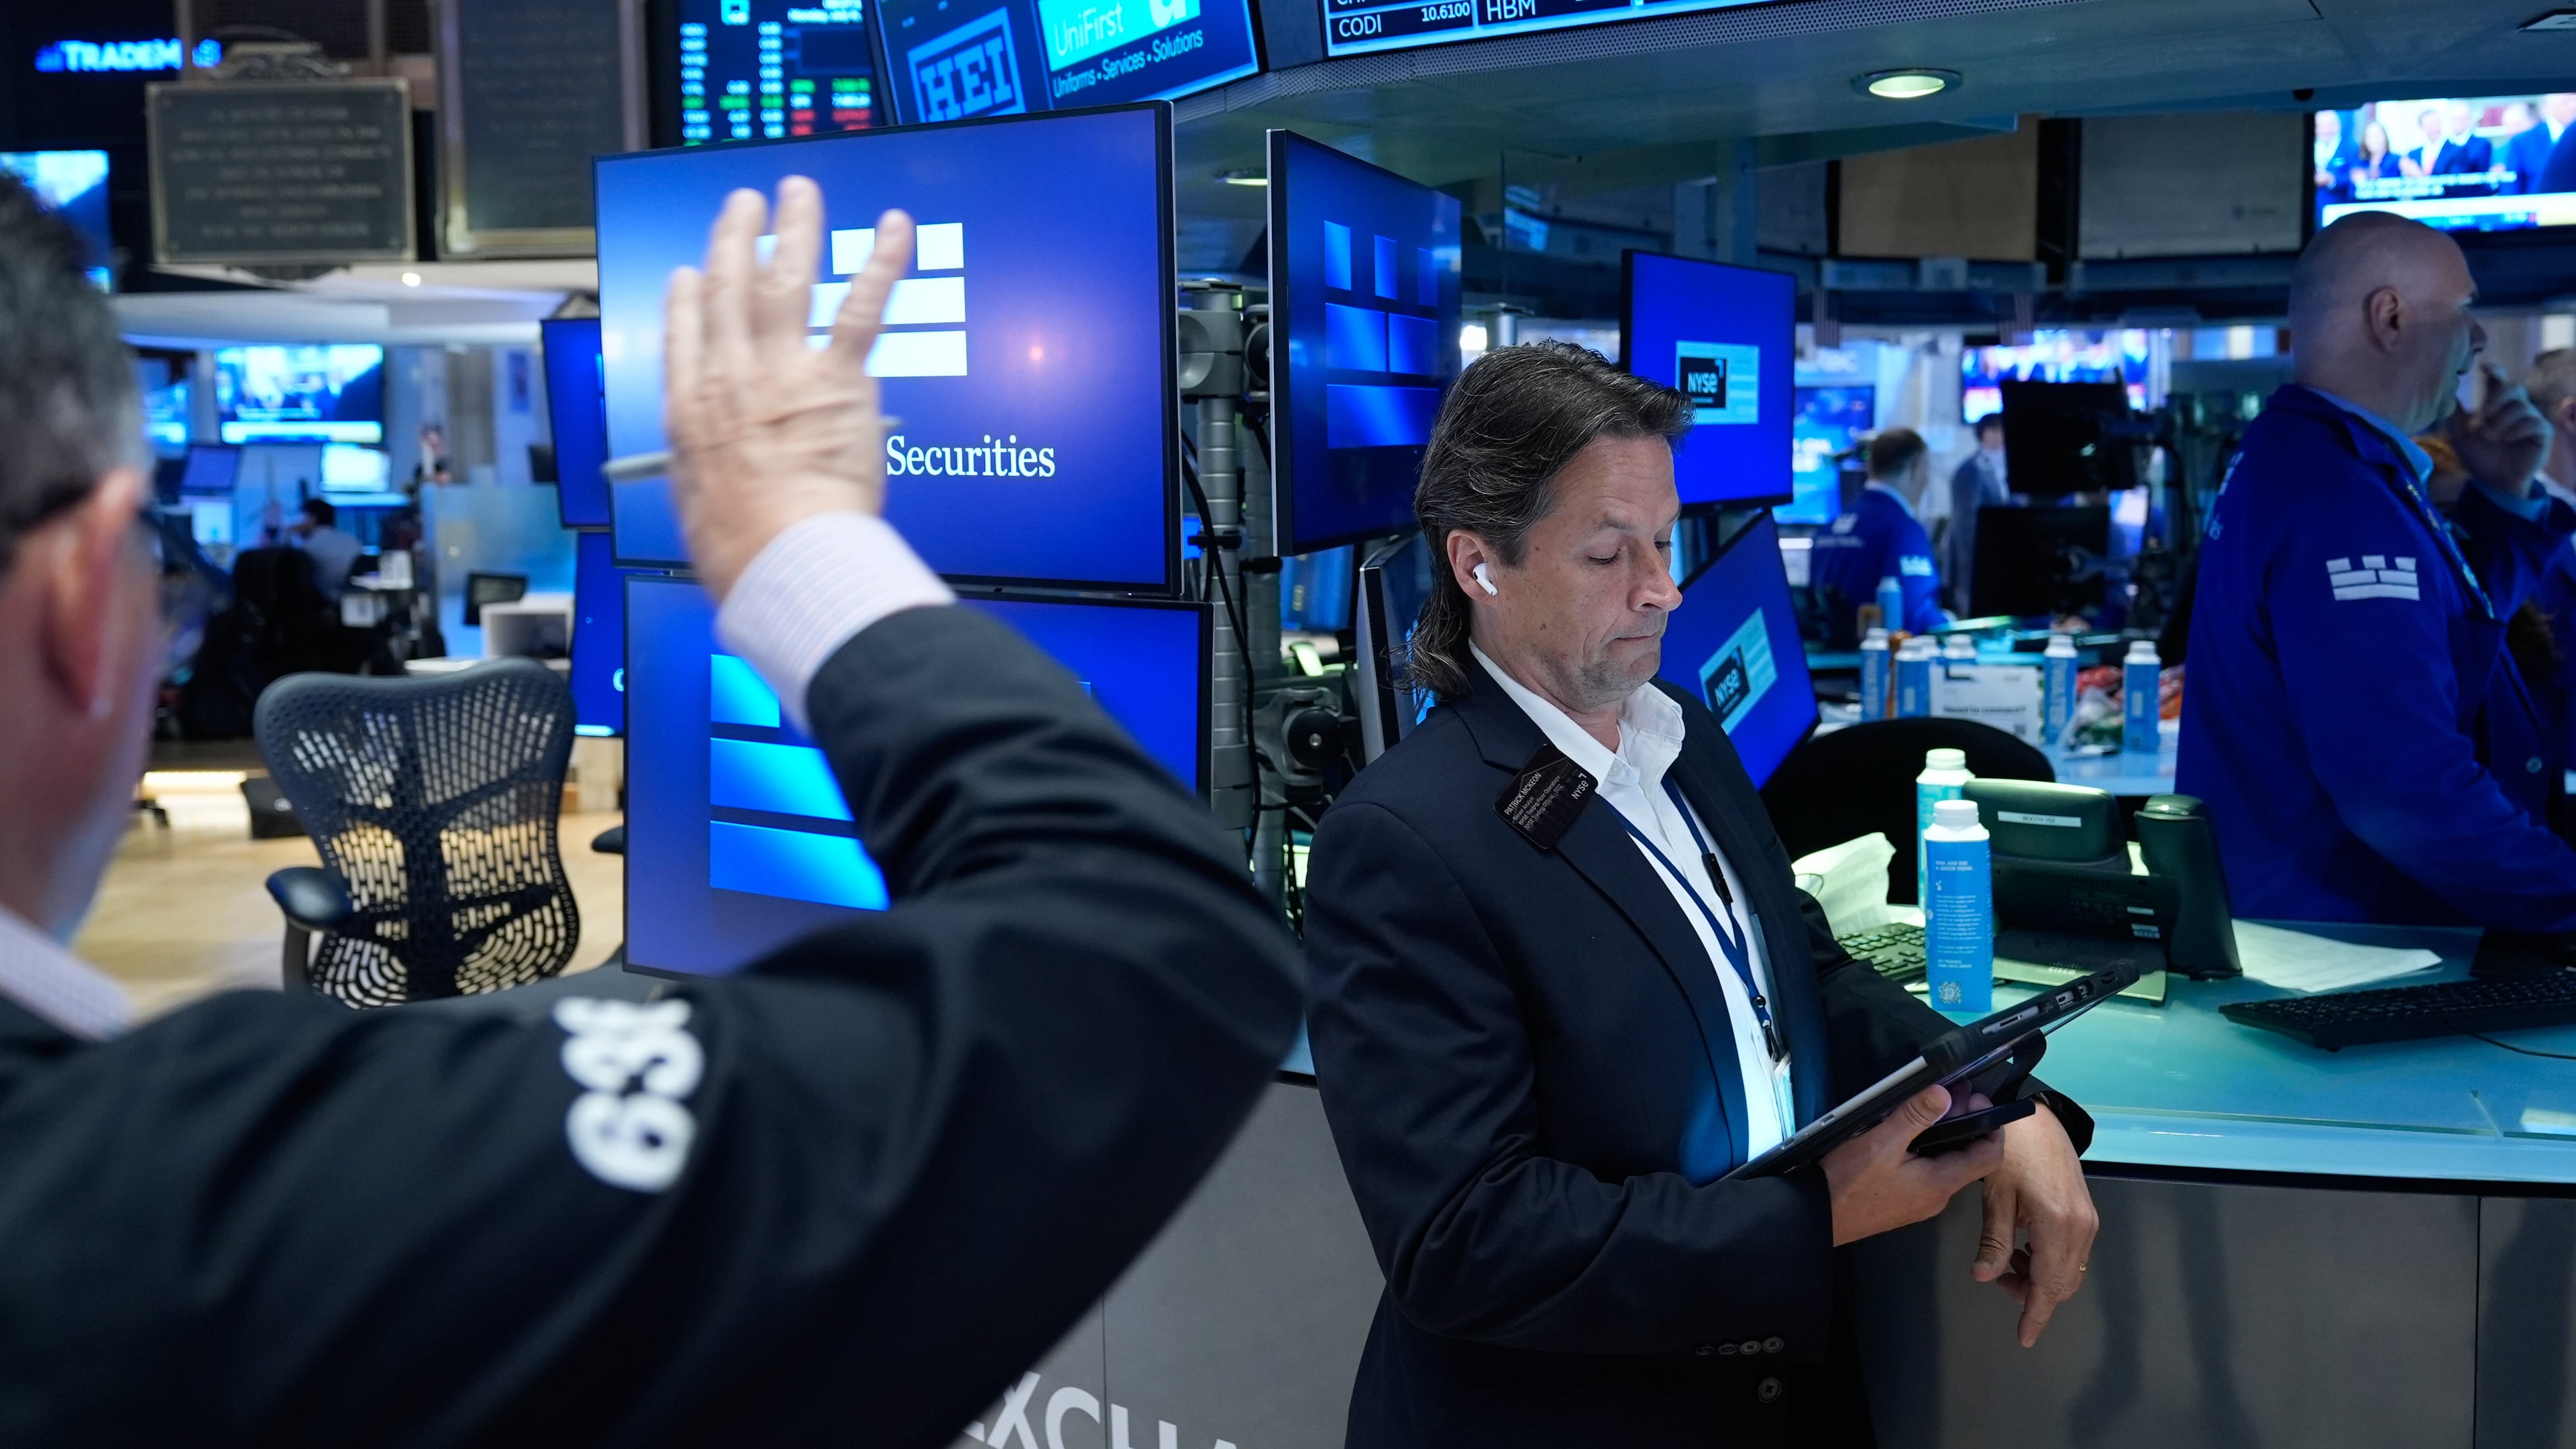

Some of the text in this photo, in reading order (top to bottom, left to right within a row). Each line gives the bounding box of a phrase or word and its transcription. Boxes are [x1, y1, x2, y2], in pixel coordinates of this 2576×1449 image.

[1055, 1, 1124, 56] UniFirst
[1338, 2, 1470, 37] CODI 10.6100
[919, 36, 1014, 123] HEI
[1053, 30, 1203, 97] Uniforms Services Solutions
[886, 434, 1055, 477] Securities
[1505, 772, 1542, 815] PATRICK MCKEON
